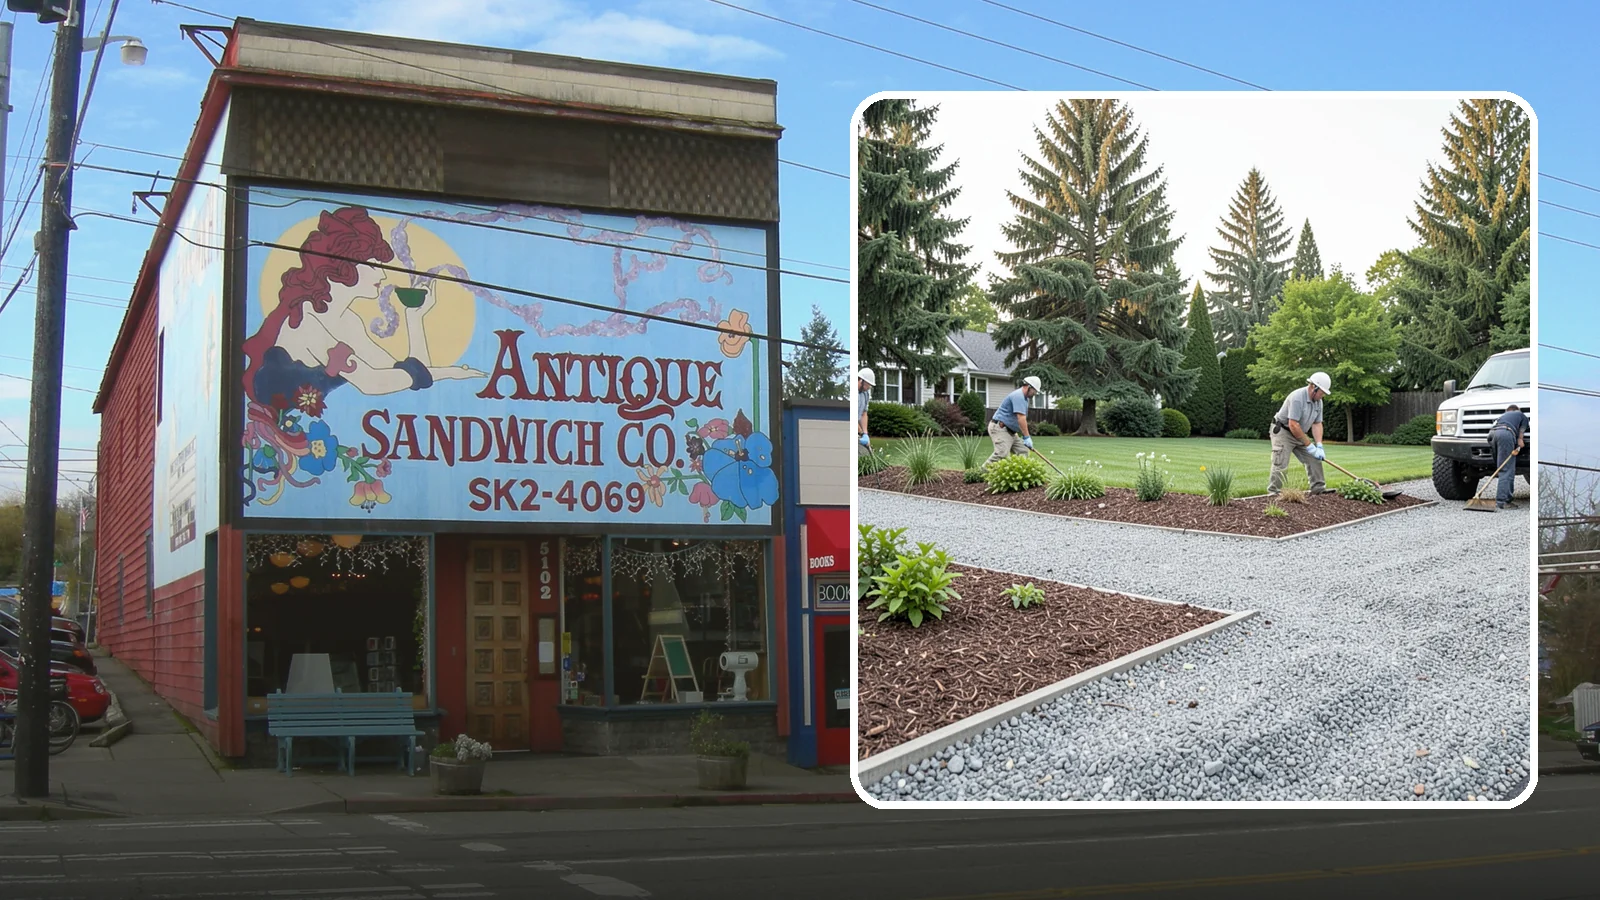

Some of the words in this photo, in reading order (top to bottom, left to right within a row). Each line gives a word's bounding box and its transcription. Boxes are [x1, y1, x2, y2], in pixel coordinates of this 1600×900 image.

[475, 328, 723, 421] ANTIQUE
[361, 408, 604, 467] SANDWICH
[617, 421, 685, 469] CO.
[468, 477, 646, 513] SK2-4069
[539, 541, 552, 600] 5102
[809, 555, 835, 569] BOOKS
